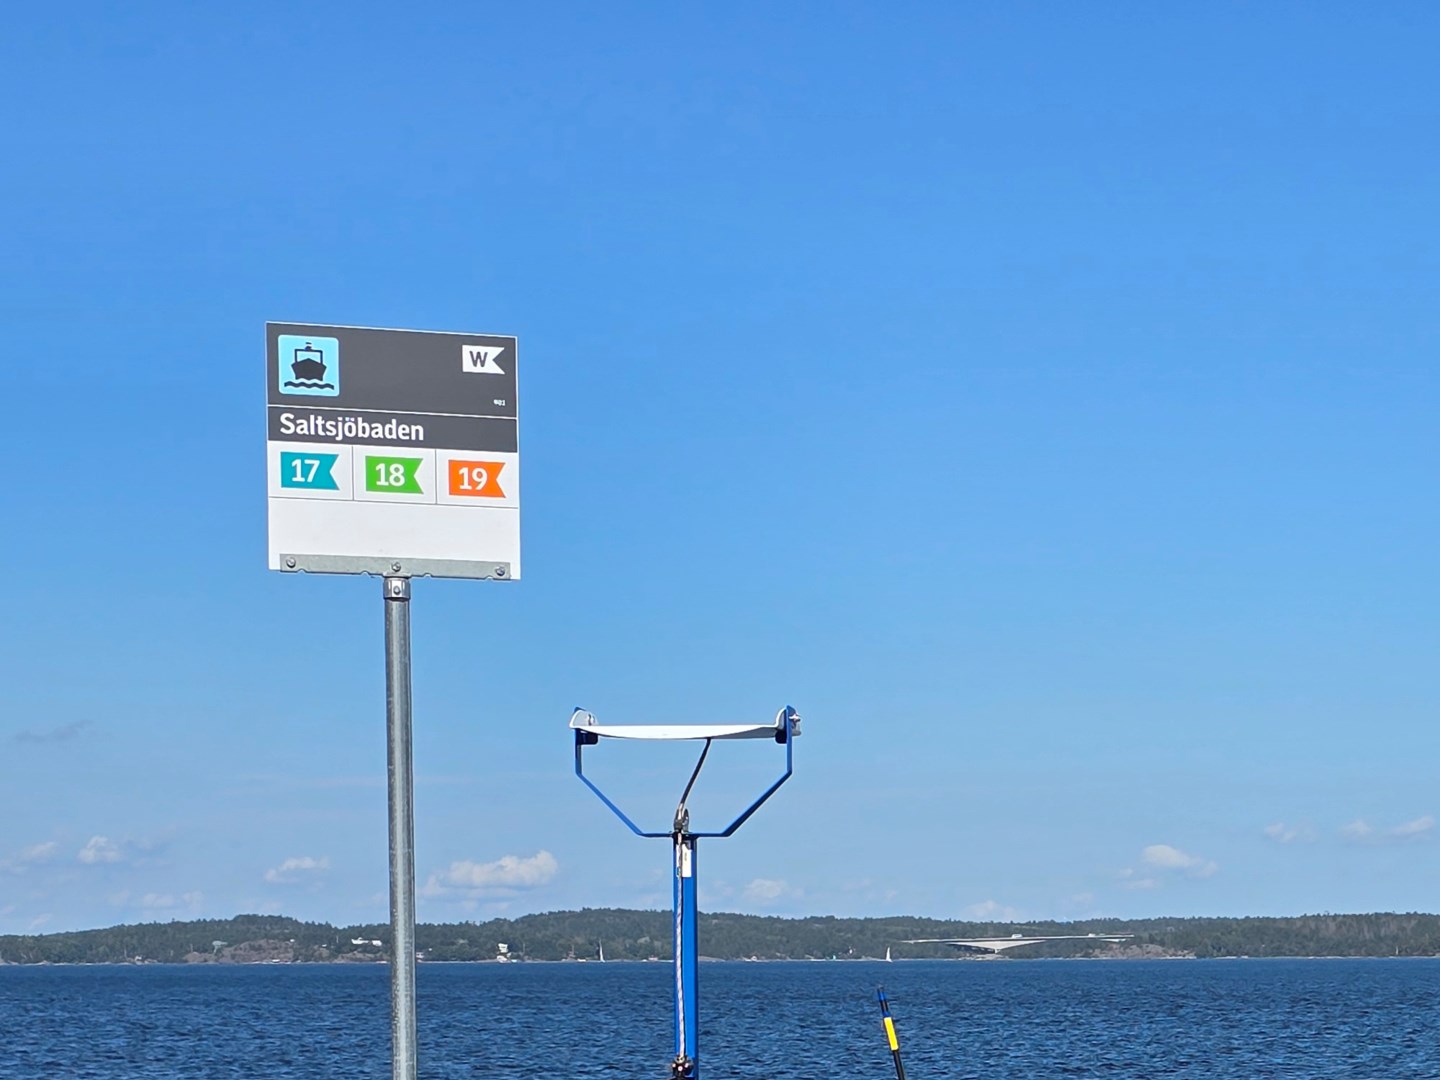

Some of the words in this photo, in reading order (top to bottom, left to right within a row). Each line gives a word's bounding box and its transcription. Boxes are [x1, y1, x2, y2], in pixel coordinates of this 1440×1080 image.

[469, 350, 488, 368] W
[280, 412, 424, 441] Saltsjöbaden
[291, 458, 320, 482] 17
[375, 462, 406, 487] 18
[458, 467, 488, 490] 19
